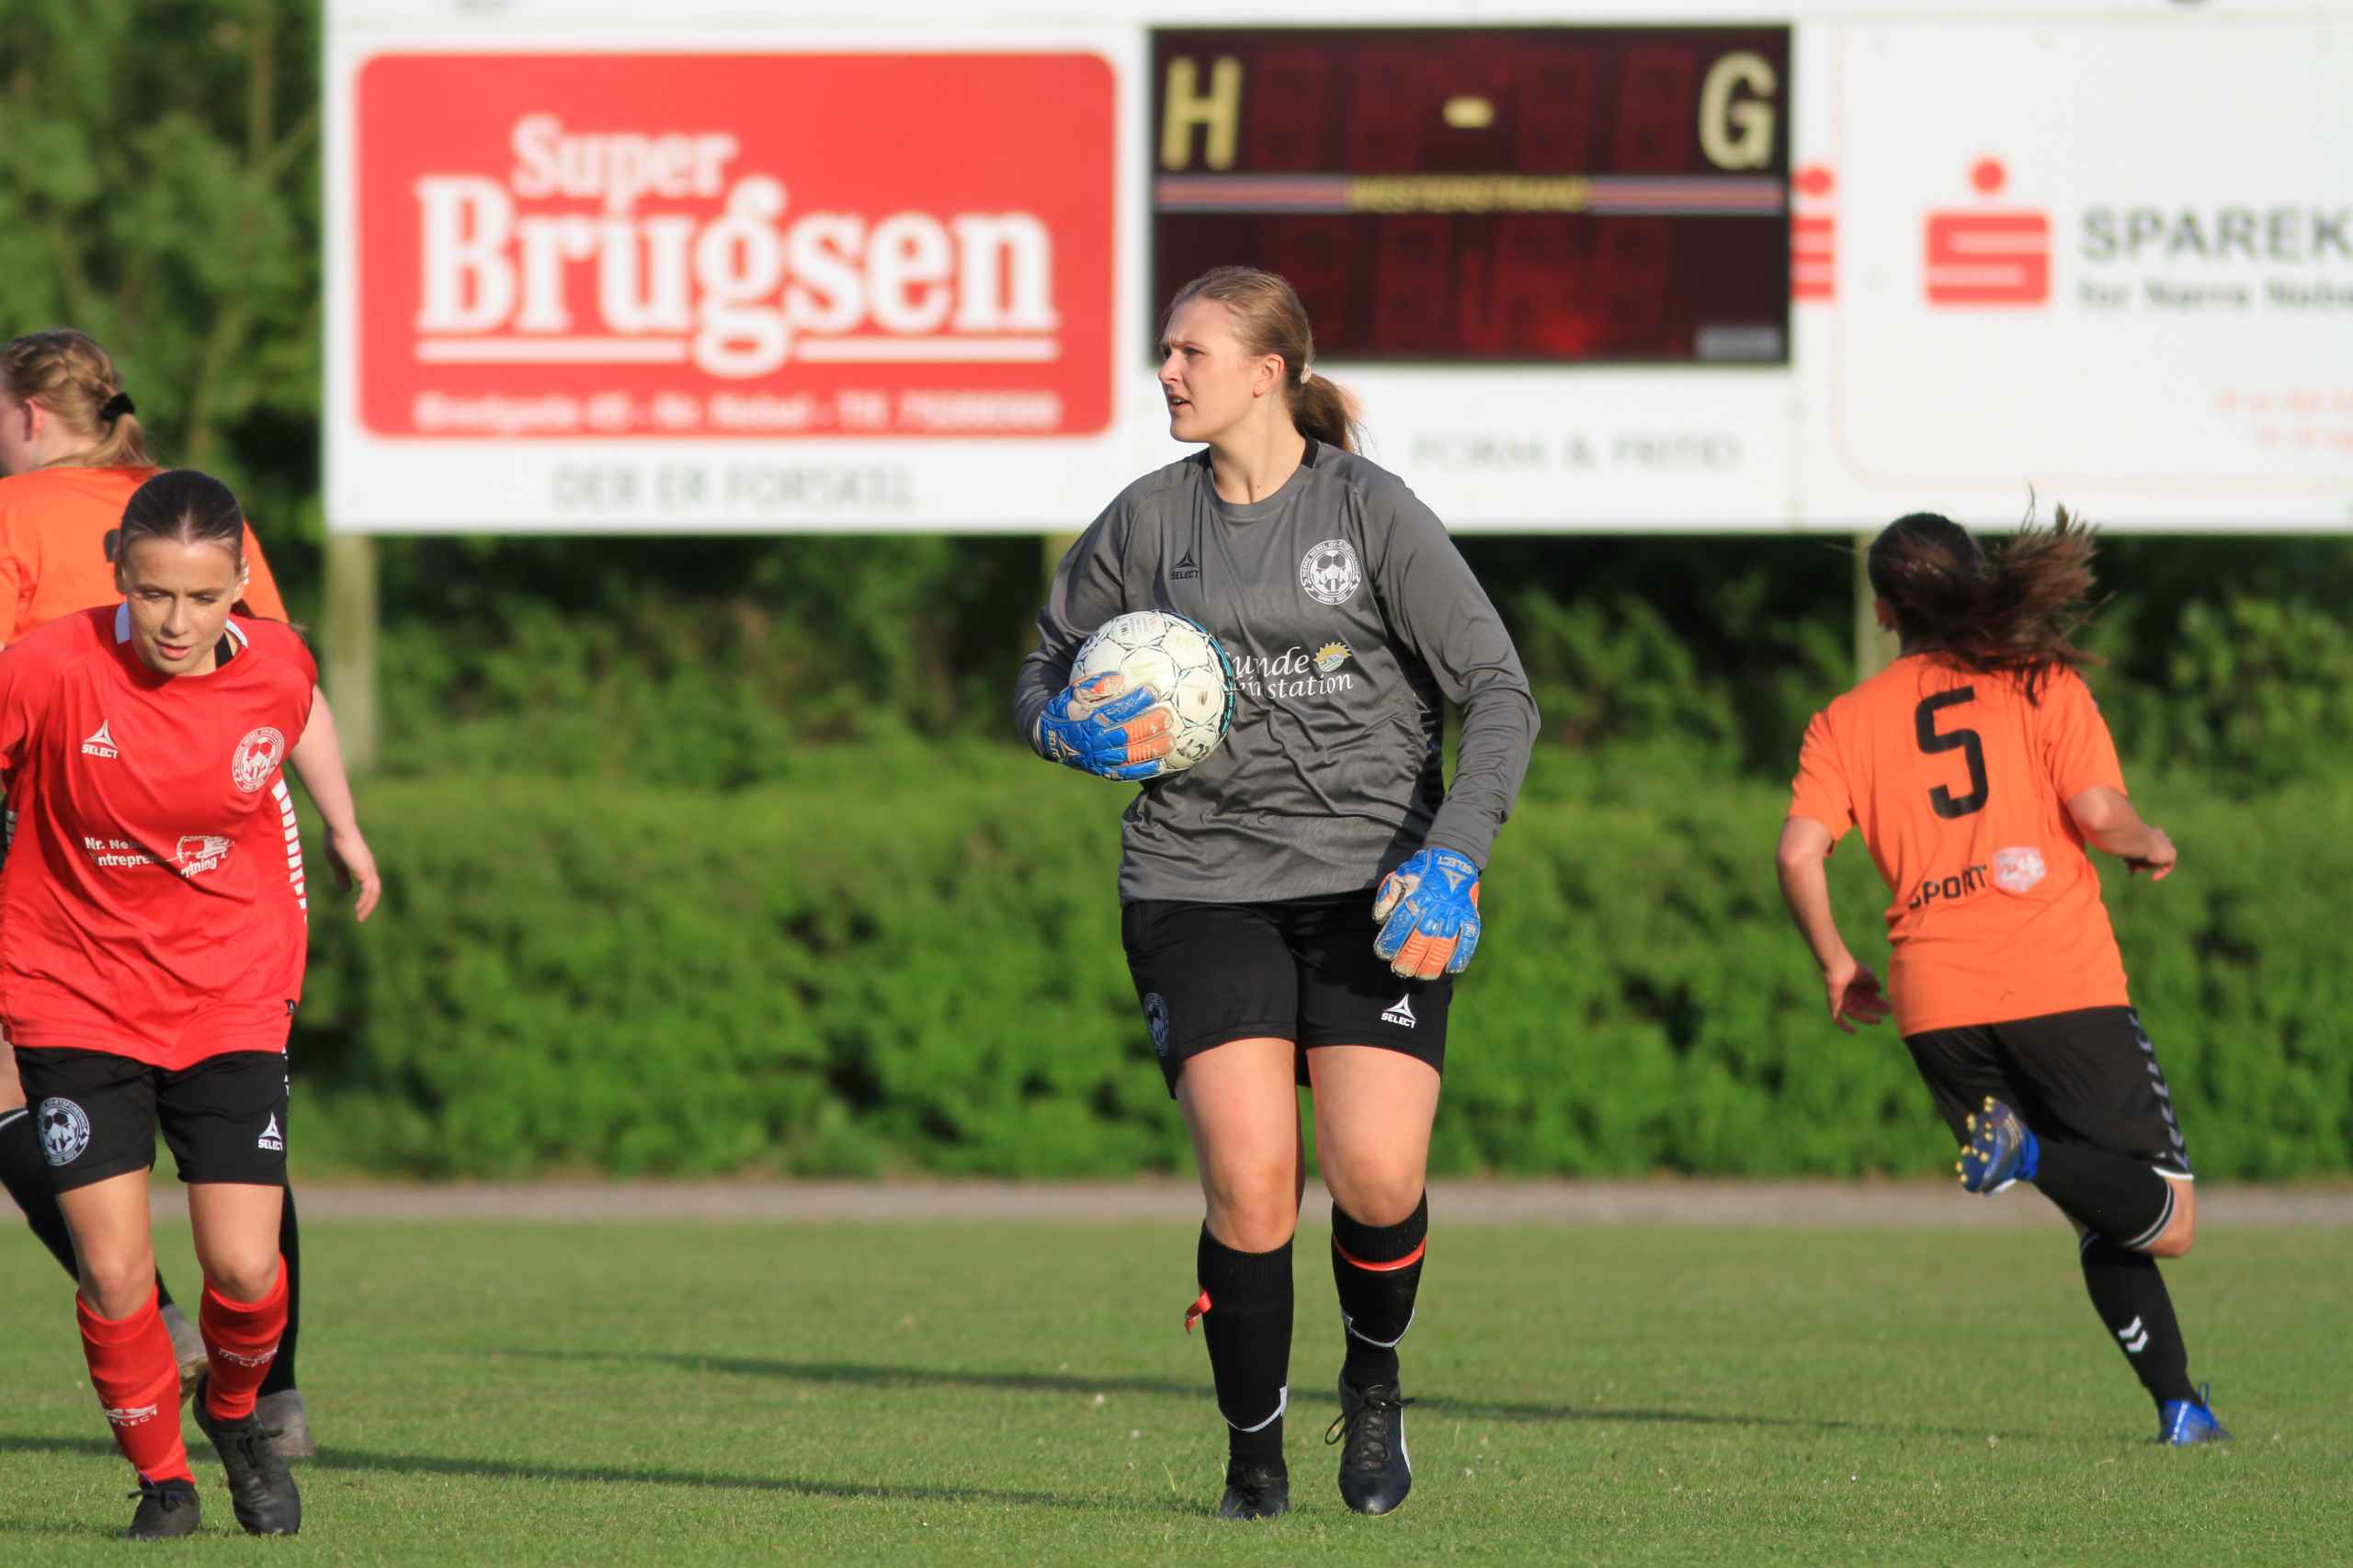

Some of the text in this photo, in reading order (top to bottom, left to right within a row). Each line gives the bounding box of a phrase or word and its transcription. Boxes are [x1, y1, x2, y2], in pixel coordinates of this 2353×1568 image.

[1159, 56, 1242, 172] H
[1699, 51, 1778, 171] G
[511, 112, 737, 212] Super
[2080, 205, 2353, 265] SPAREK
[415, 173, 1059, 378] Brugsen
[1170, 570, 1199, 580] SELECT
[1226, 646, 1310, 677] unde
[82, 744, 119, 758] SELECT
[1915, 686, 1989, 819] 5
[1381, 1012, 1416, 1028] SELECT
[257, 1138, 283, 1151] SELECT
